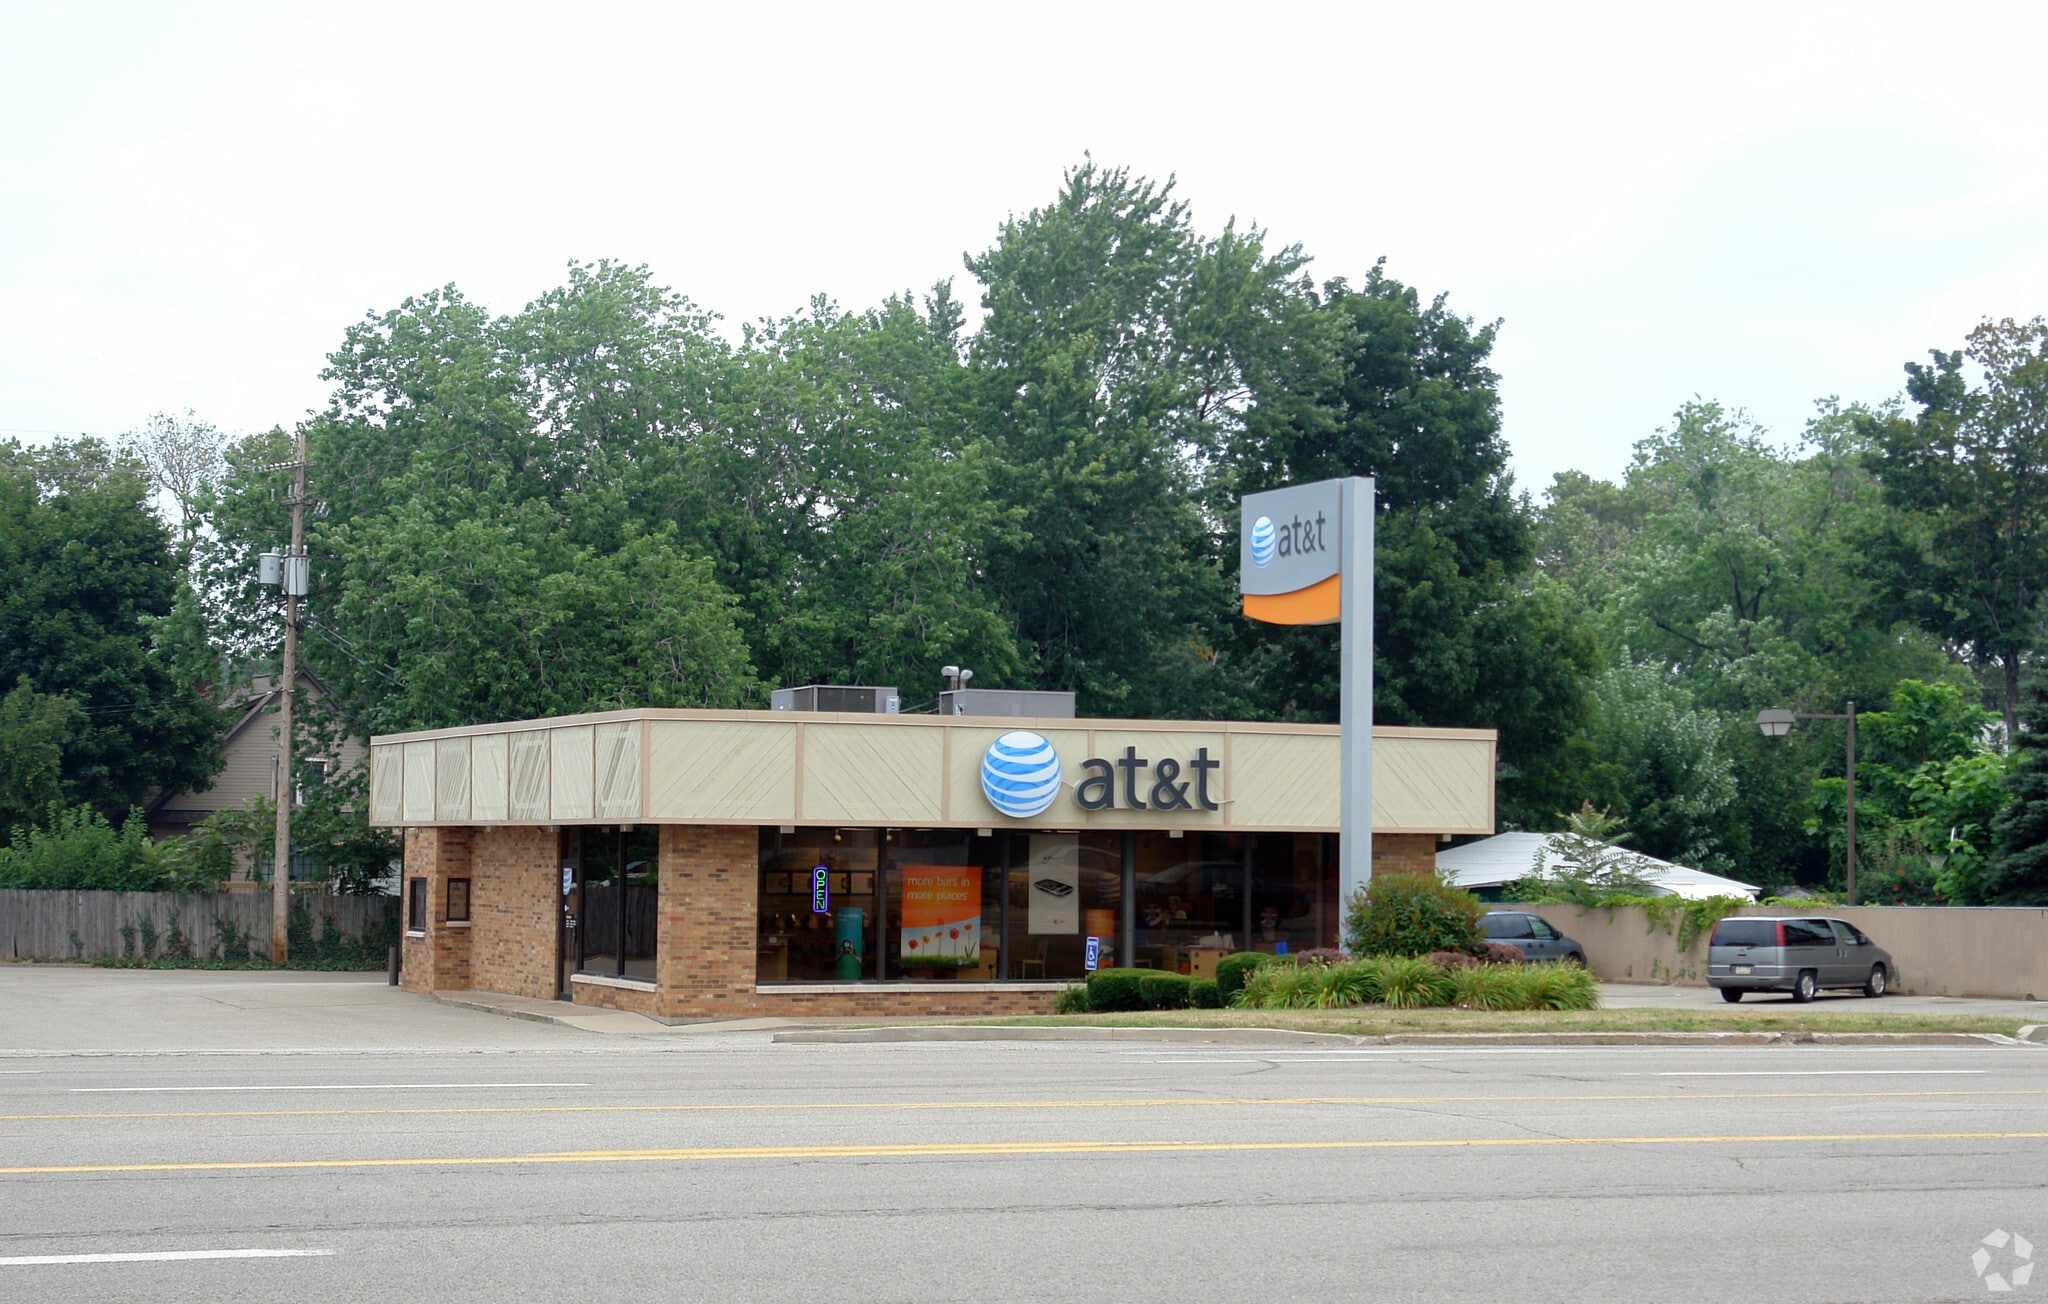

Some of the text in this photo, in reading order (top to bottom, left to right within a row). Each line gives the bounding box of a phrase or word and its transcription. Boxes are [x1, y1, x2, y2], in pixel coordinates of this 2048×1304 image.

[1278, 510, 1326, 557] at&t
[1075, 745, 1221, 812] at&t
[816, 869, 826, 910] OPEN
[907, 875, 970, 887] more bars in
[907, 890, 933, 900] more
